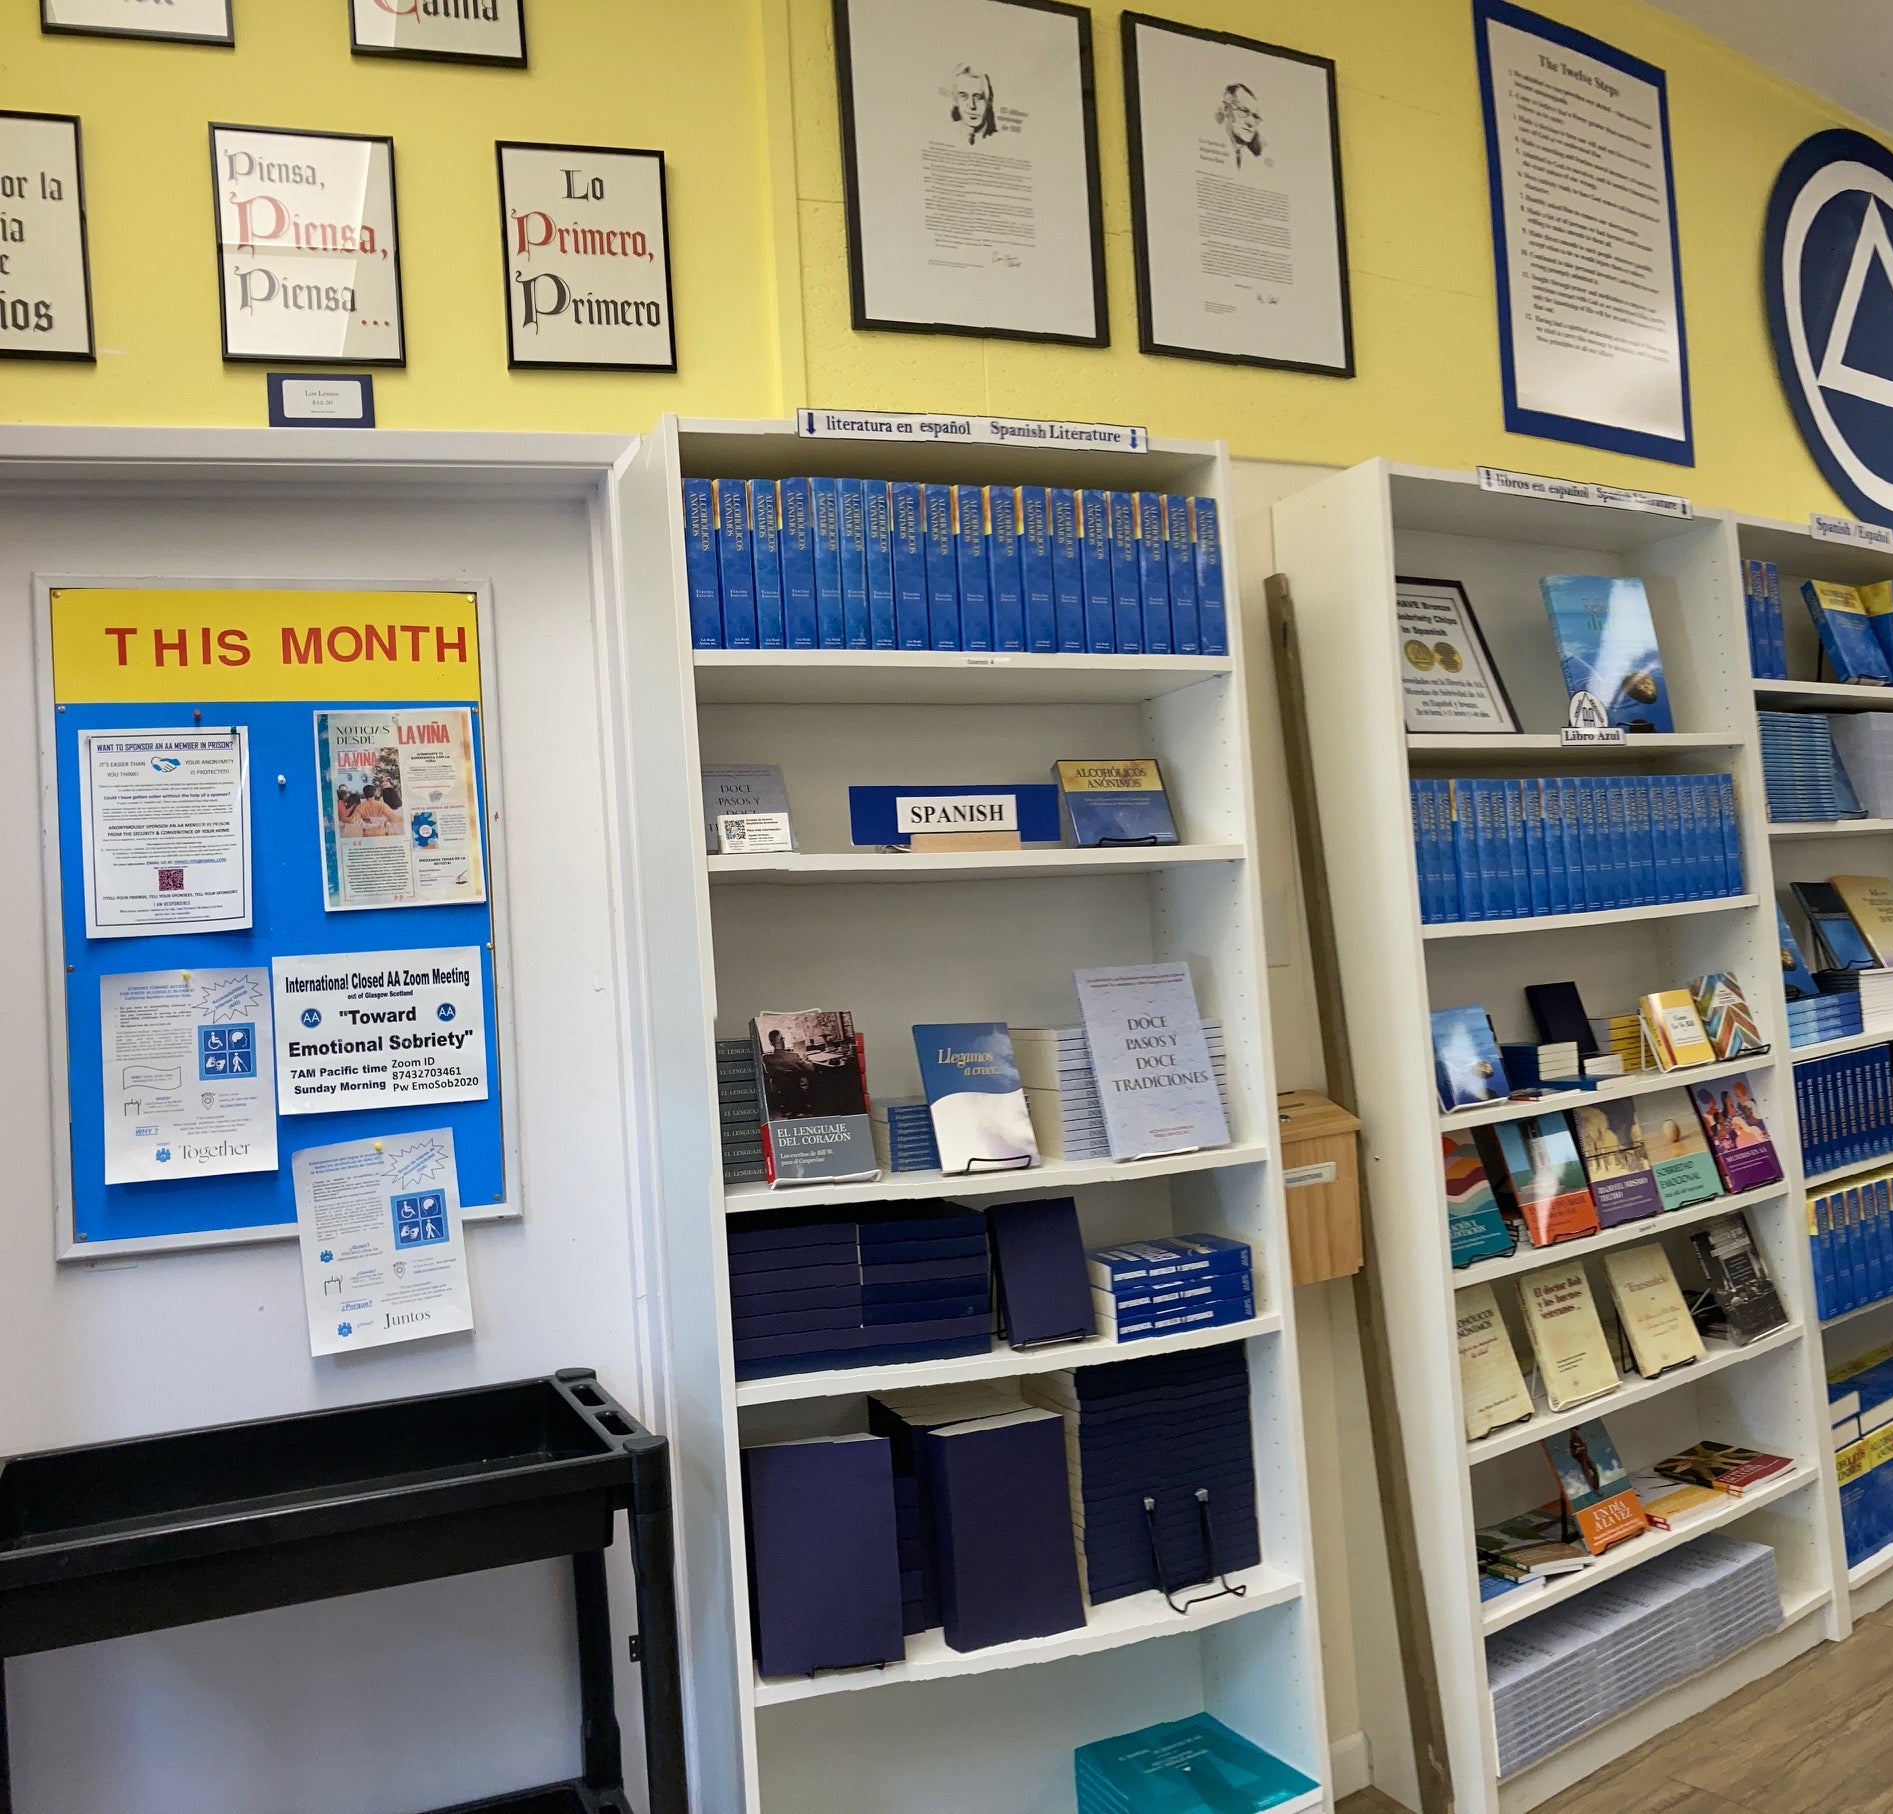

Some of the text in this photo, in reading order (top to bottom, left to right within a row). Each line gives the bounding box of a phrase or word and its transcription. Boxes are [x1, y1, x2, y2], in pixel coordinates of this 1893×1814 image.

[224, 149, 325, 190] Piensa,
[40, 171, 63, 201] la
[561, 169, 604, 201] Lo
[229, 191, 388, 261] Piensa,
[511, 209, 654, 262] Primero,
[516, 270, 660, 334] Primero
[826, 416, 1121, 443] literatura en español Spanish Literature
[105, 624, 468, 667] THIS MONTH
[337, 736, 375, 745] DESDE
[398, 721, 449, 745] LA VIÑA
[1565, 731, 1620, 741] Libro Azul
[910, 803, 1005, 825] SPANISH
[286, 968, 469, 993] International Closed AA Zoom Meeting
[365, 992, 388, 1000] Glasgow
[303, 1013, 320, 1023] AA
[340, 1007, 416, 1025] "Toward
[439, 1007, 455, 1016] AA
[1128, 1016, 1168, 1030] DOCE
[289, 1030, 473, 1057] Emotional Sobriety"
[1126, 1034, 1177, 1050] PASOS Y
[392, 1057, 434, 1068] Zoom ID
[938, 1050, 993, 1067] Llegamos
[1136, 1054, 1176, 1069] DOCE
[291, 1064, 388, 1079] 7AM Pacific time
[393, 1067, 461, 1080] 87432703461
[294, 1080, 386, 1095] Sunday Morning
[394, 1077, 478, 1092] Pw EmoSob2020
[1113, 1071, 1209, 1092] TRADICIONES
[777, 1123, 847, 1138] EL LENGUAJE
[779, 1131, 851, 1147] DEL CORAZÓN
[179, 1141, 251, 1163] Together
[383, 1309, 430, 1330] Juntos
